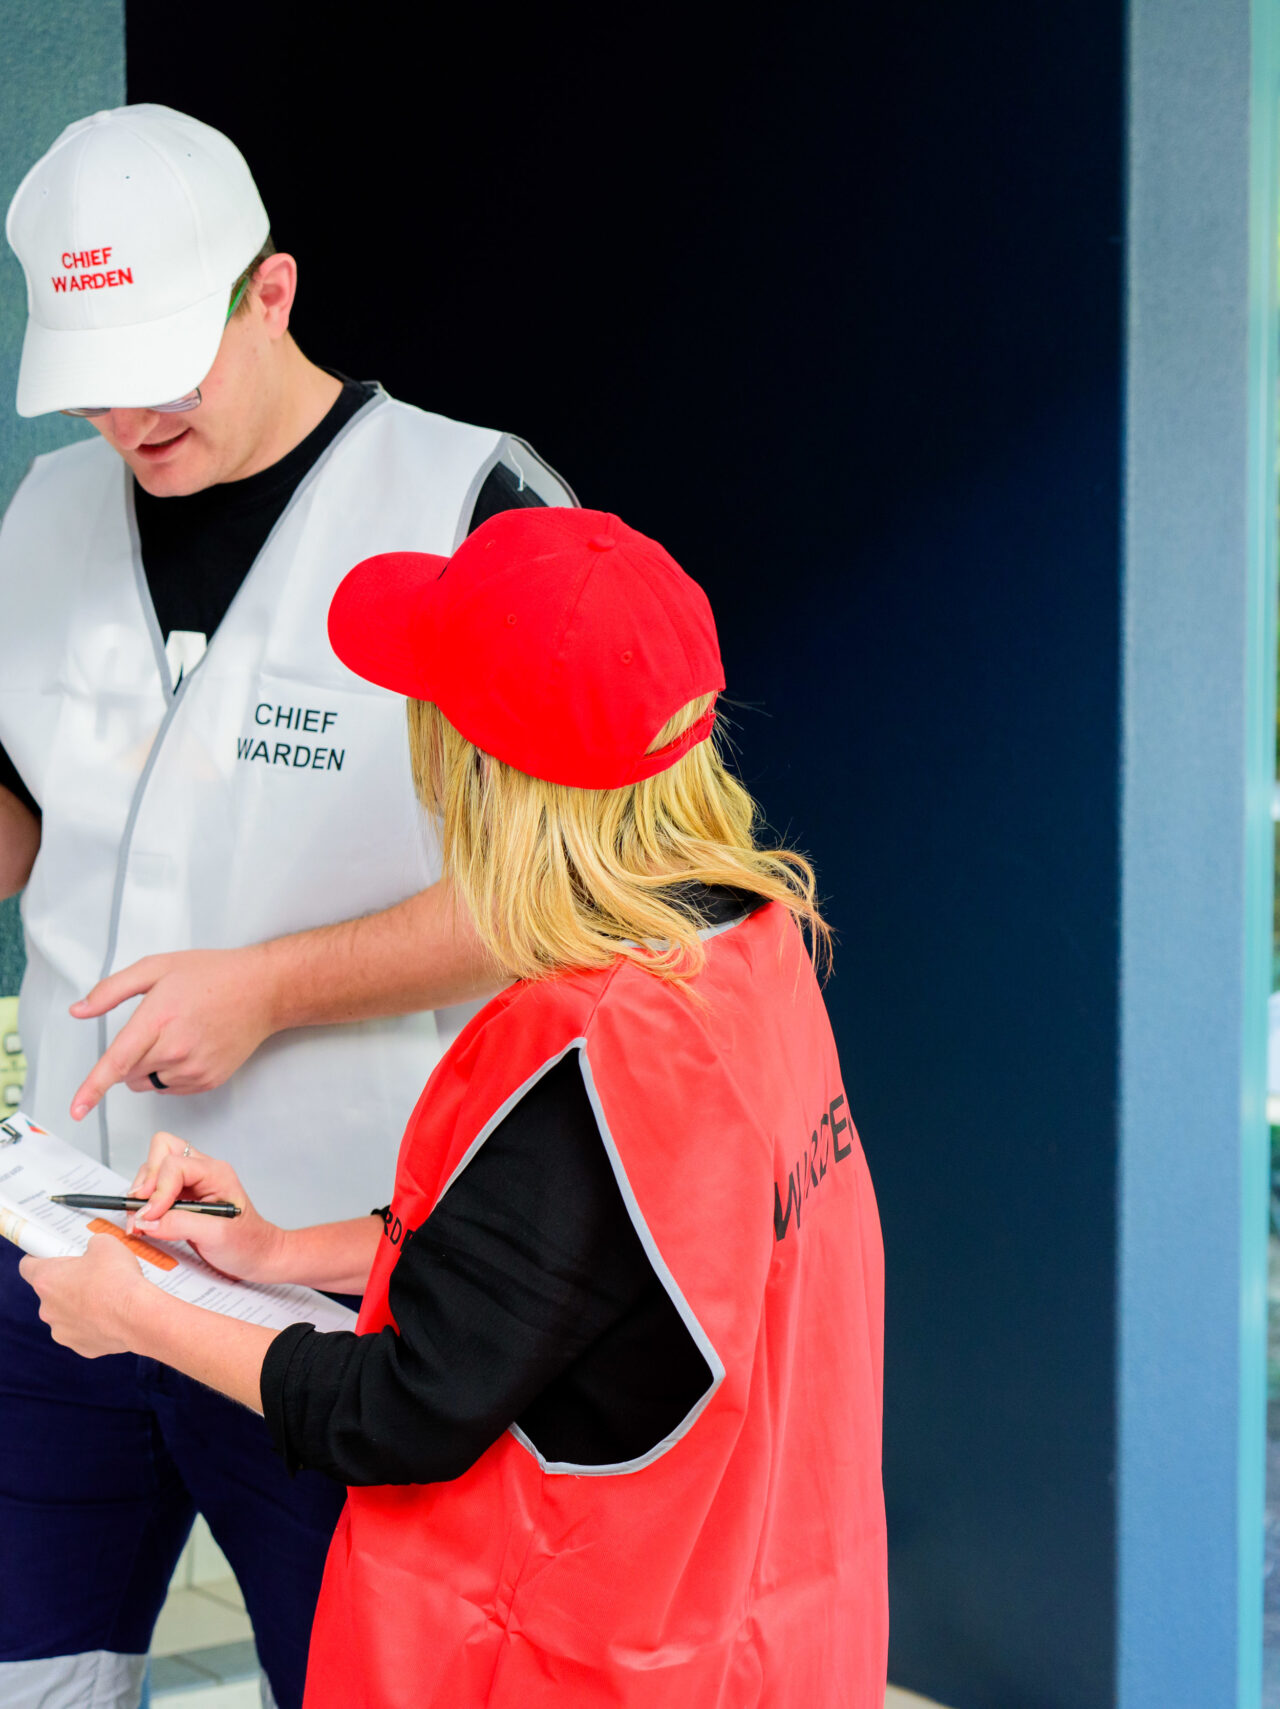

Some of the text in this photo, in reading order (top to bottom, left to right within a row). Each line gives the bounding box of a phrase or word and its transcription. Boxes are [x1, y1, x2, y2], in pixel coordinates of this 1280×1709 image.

[61, 247, 112, 269] CHIEF
[51, 267, 134, 293] WARDEN
[255, 703, 338, 733] CHIEF
[237, 737, 345, 771] WARDEN
